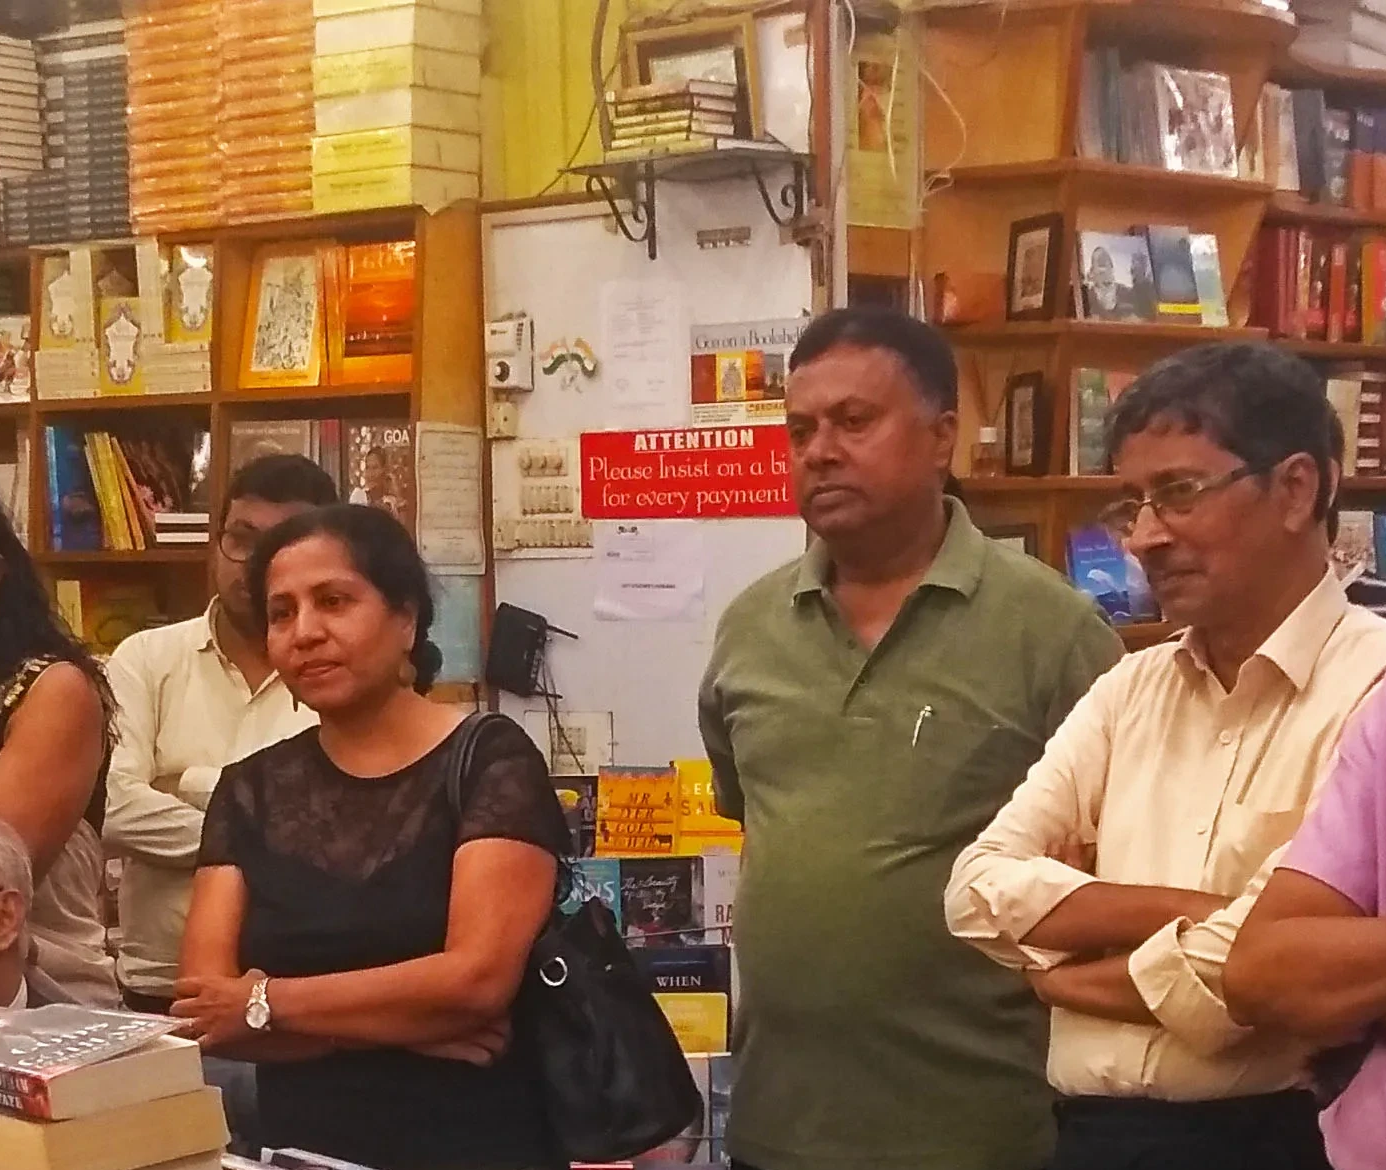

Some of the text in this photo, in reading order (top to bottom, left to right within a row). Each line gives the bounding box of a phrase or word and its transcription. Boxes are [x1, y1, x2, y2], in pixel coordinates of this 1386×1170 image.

[383, 429, 410, 444] GOA
[634, 429, 754, 452] ATTENTION
[589, 451, 789, 481] Please Insist on a bi
[601, 482, 789, 514] for every payment
[628, 791, 652, 804] MR
[616, 823, 655, 834] GOES
[715, 904, 733, 923] RA
[656, 975, 702, 988] WHEN
